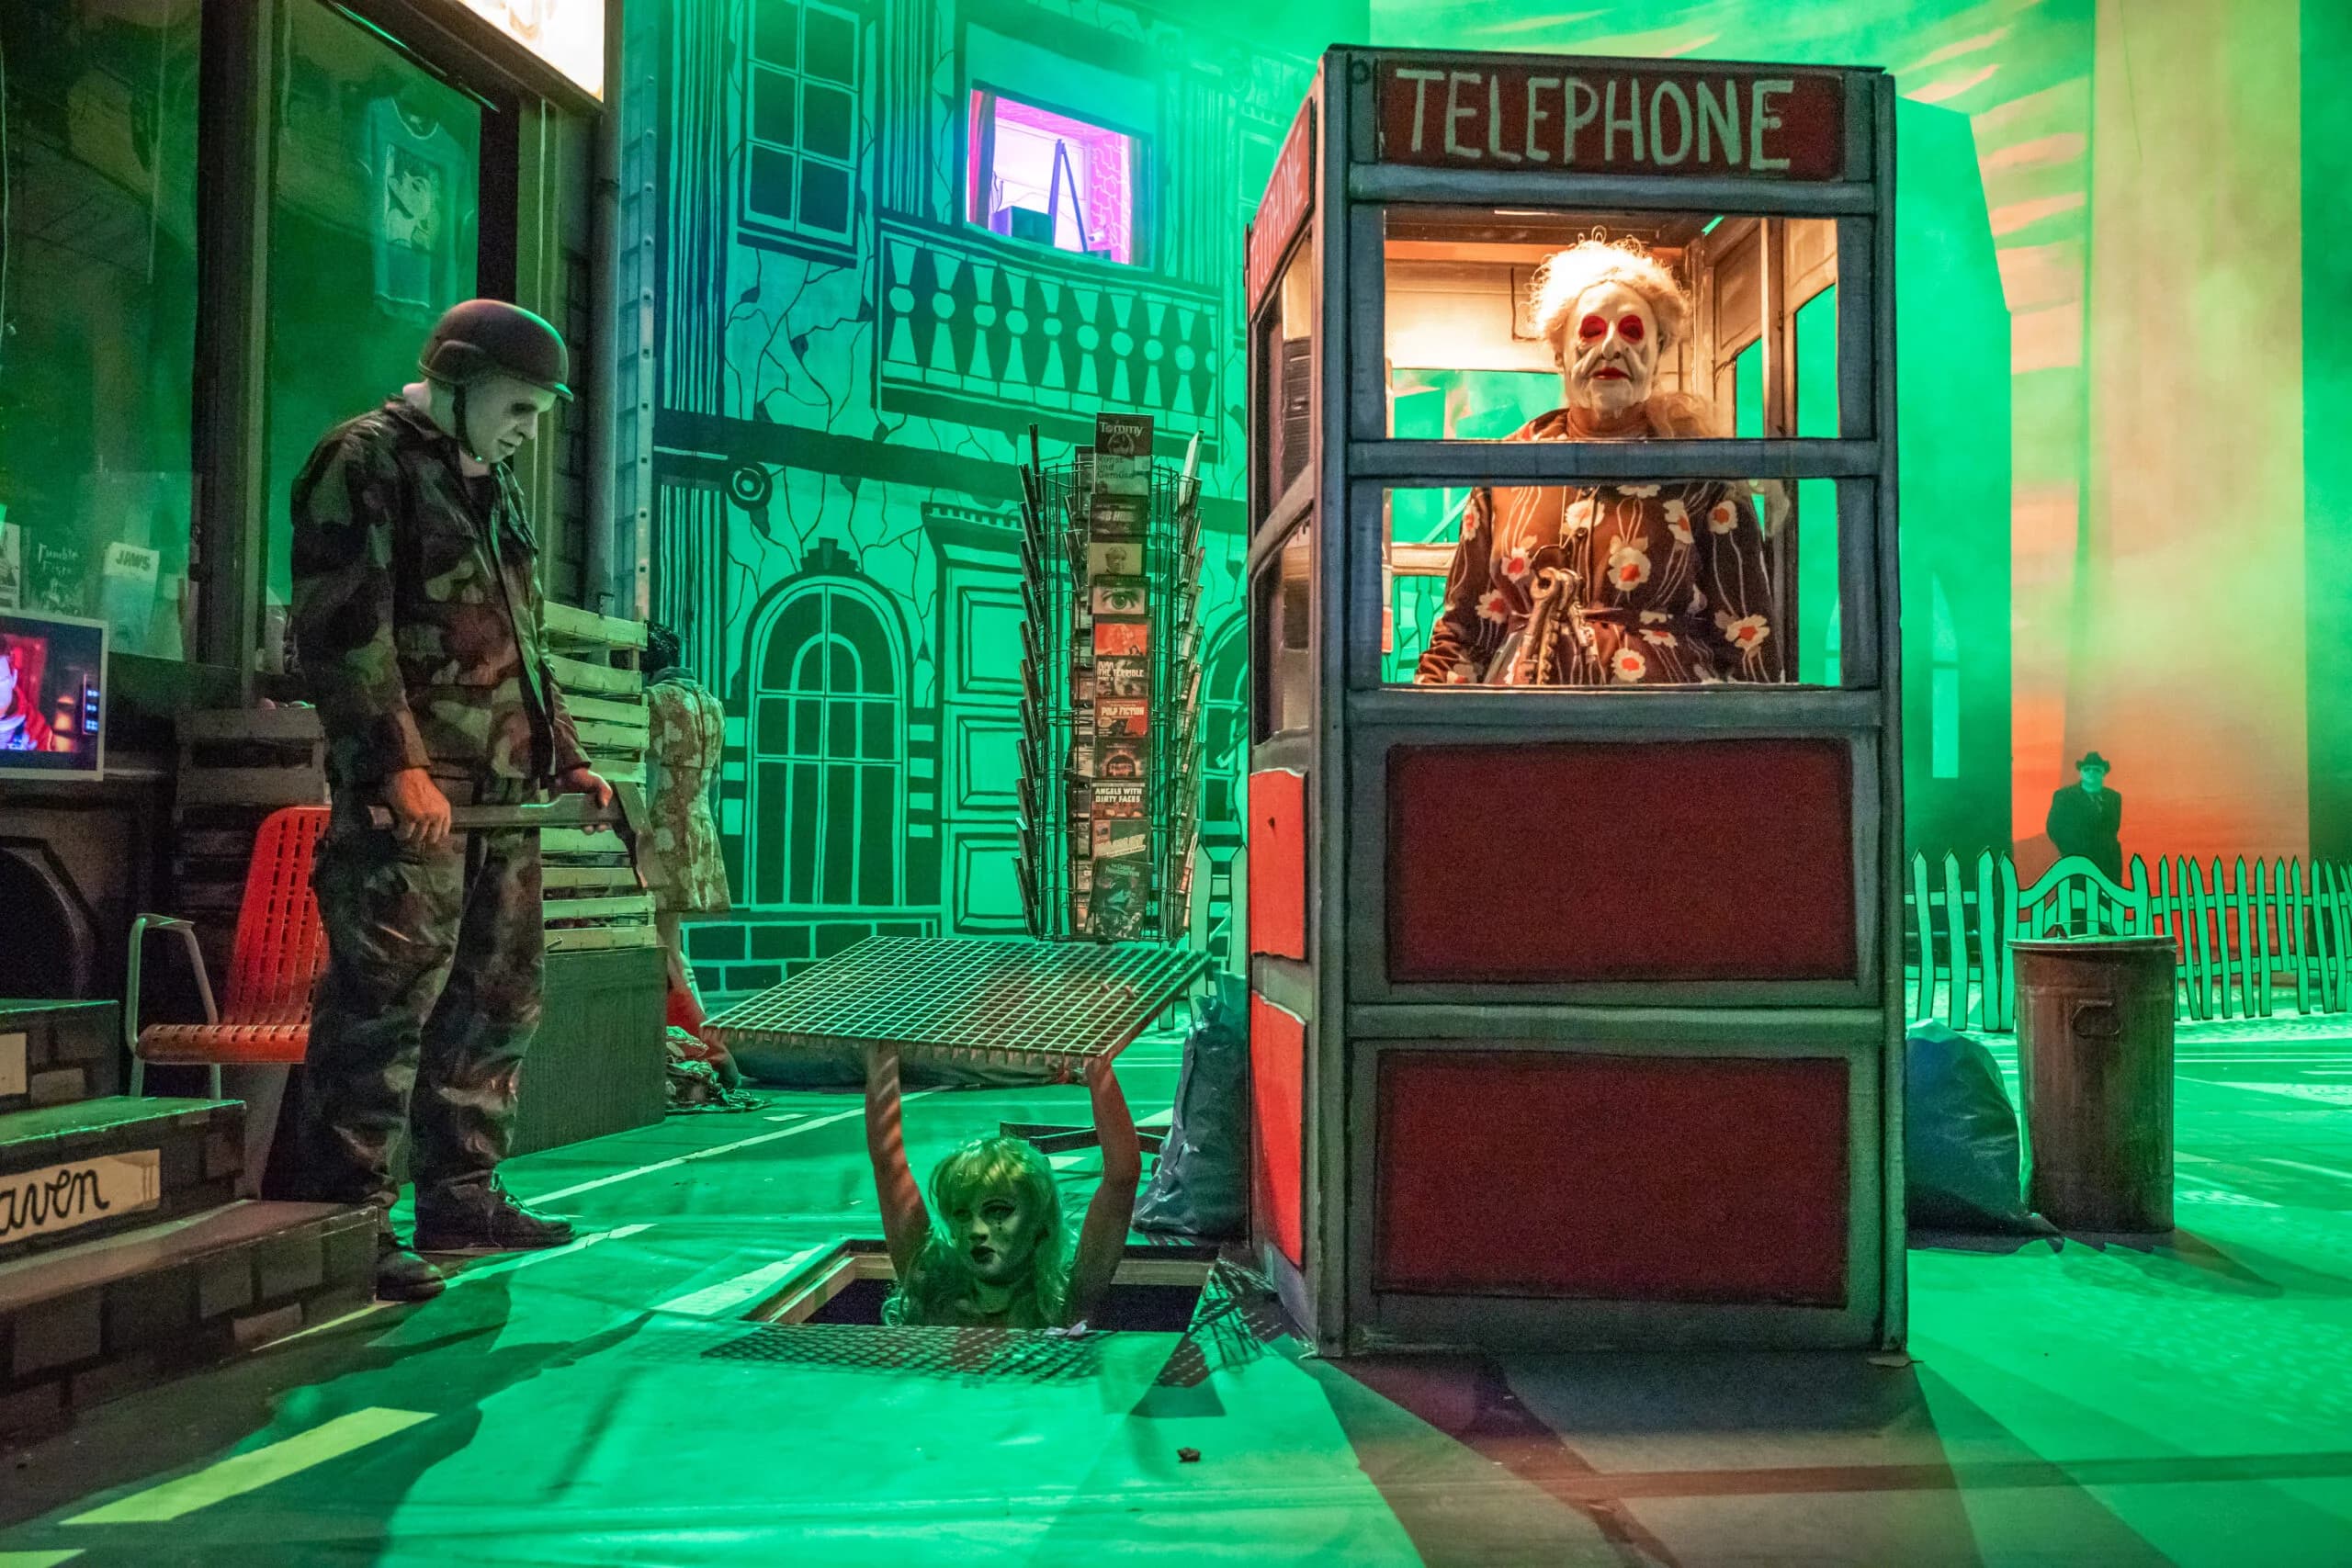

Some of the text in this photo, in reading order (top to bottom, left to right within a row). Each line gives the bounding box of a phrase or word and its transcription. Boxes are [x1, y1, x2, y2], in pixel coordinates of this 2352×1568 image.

[1396, 69, 1795, 171] TELEPHONE
[1099, 422, 1144, 435] Tommy
[115, 550, 152, 572] JAWS
[1101, 706, 1145, 716] PULP FICTION
[1095, 787, 1142, 795] ANGELS WITH
[1095, 795, 1141, 803] DIRTY FACES
[0, 1169, 110, 1235] aven
